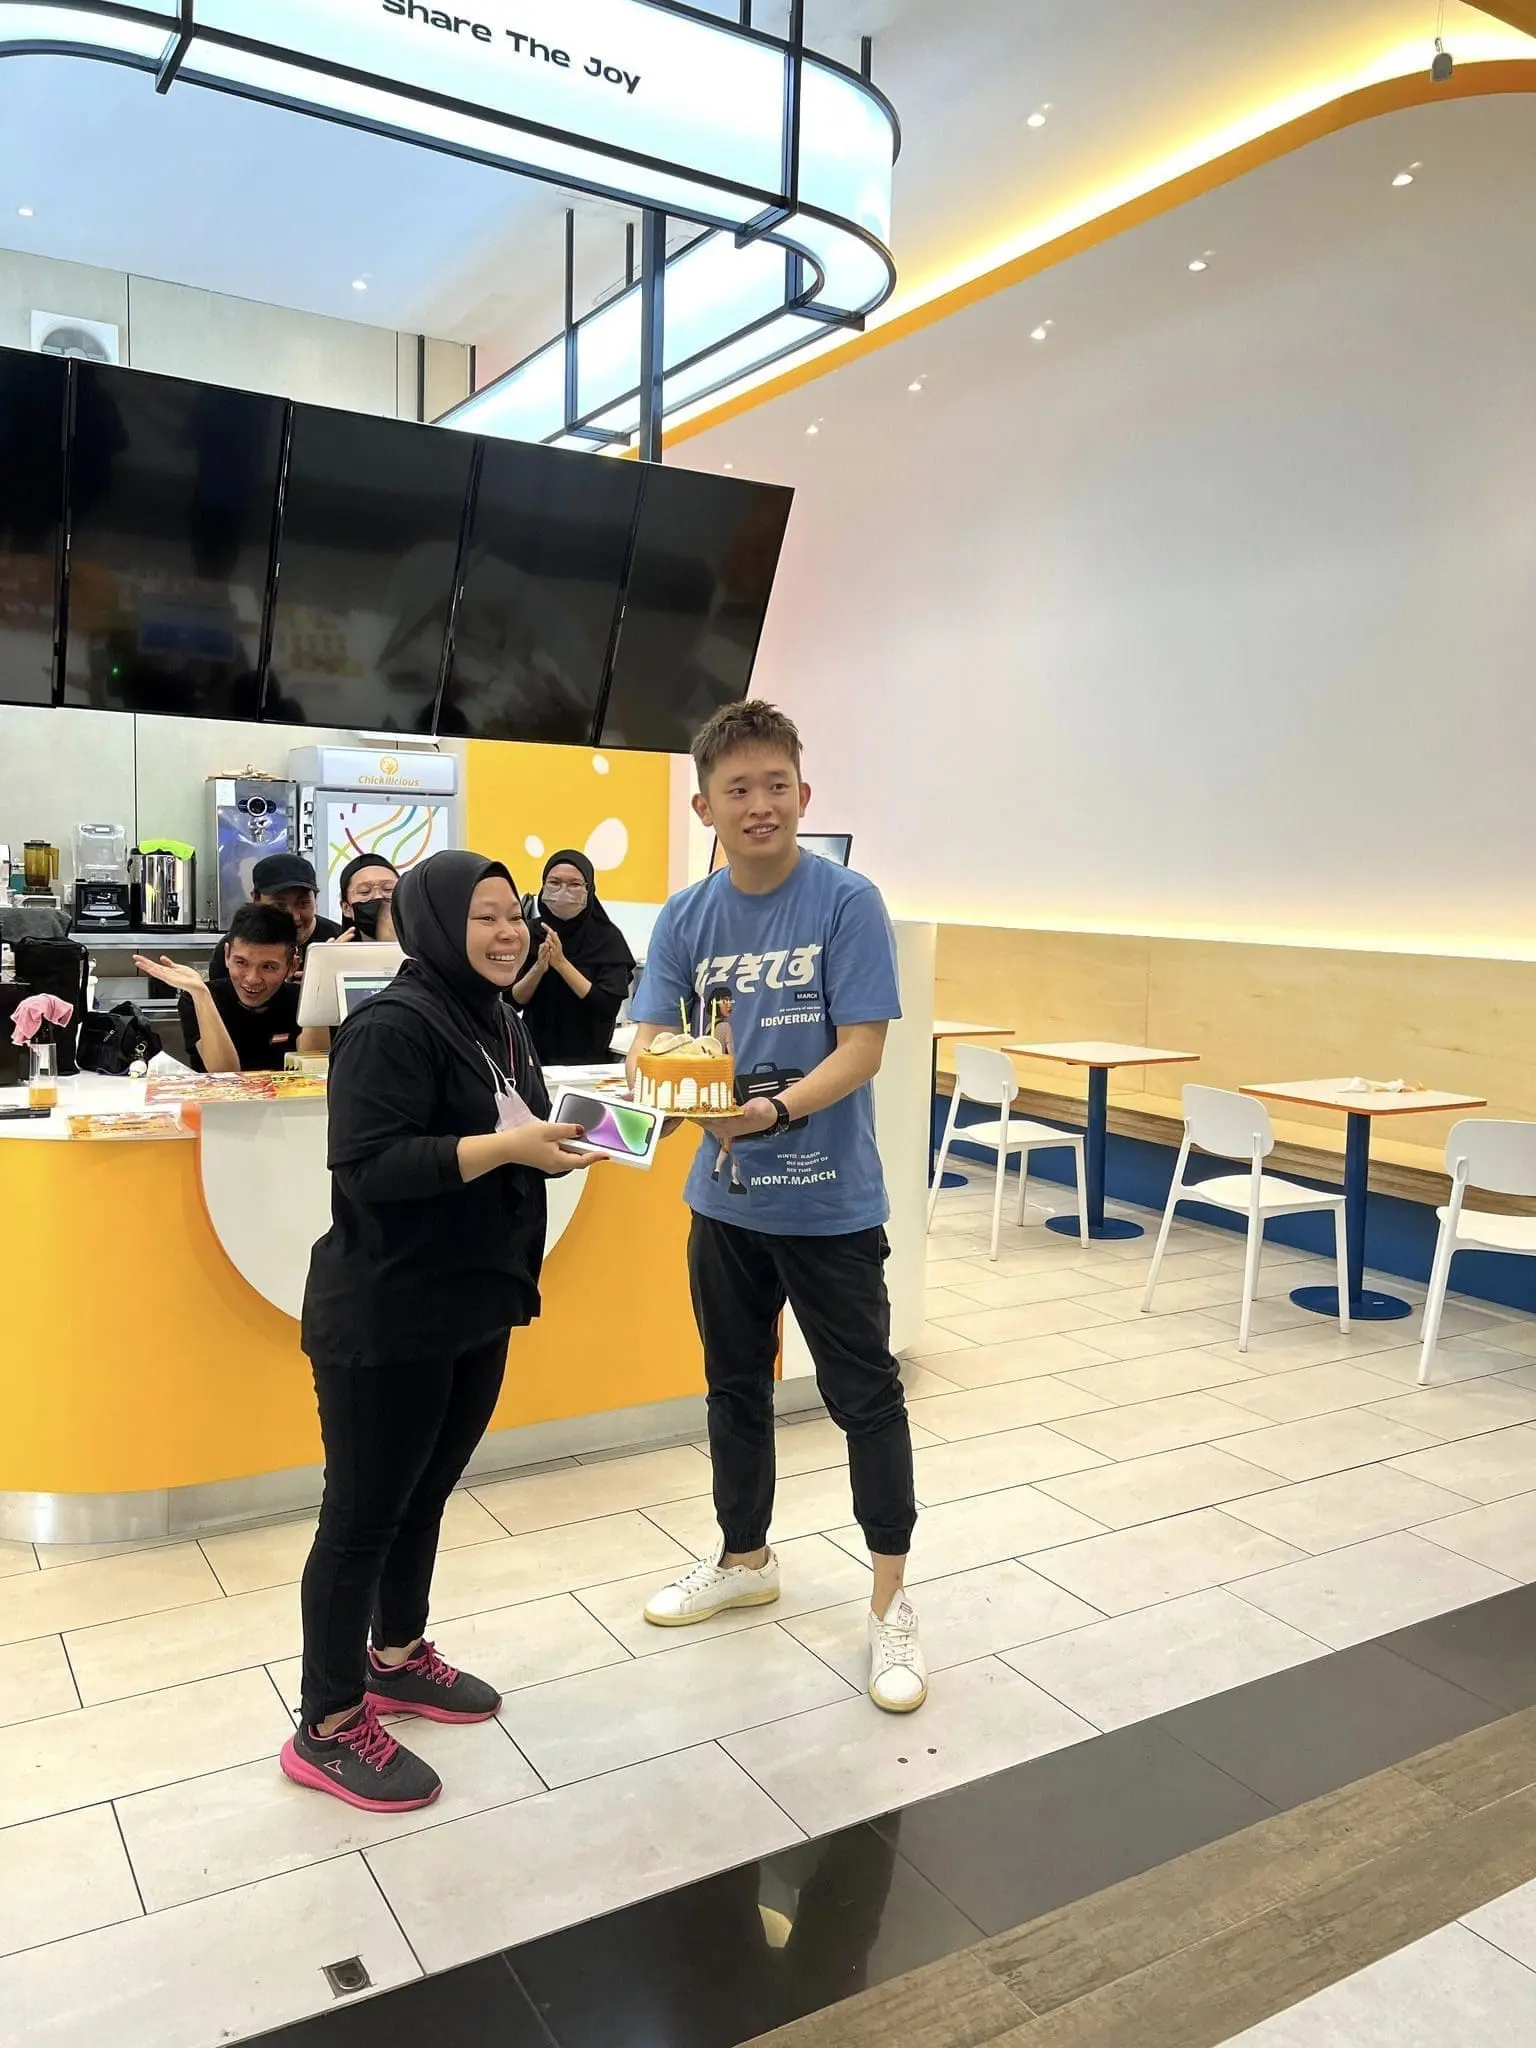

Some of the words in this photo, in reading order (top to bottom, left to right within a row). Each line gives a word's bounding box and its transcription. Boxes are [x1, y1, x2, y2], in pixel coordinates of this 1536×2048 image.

[382, 0, 492, 43] Share
[505, 29, 571, 69] The
[583, 56, 641, 95] Joy
[358, 775, 420, 787] Chickilicious
[750, 1169, 837, 1186] MONT.MARCH
